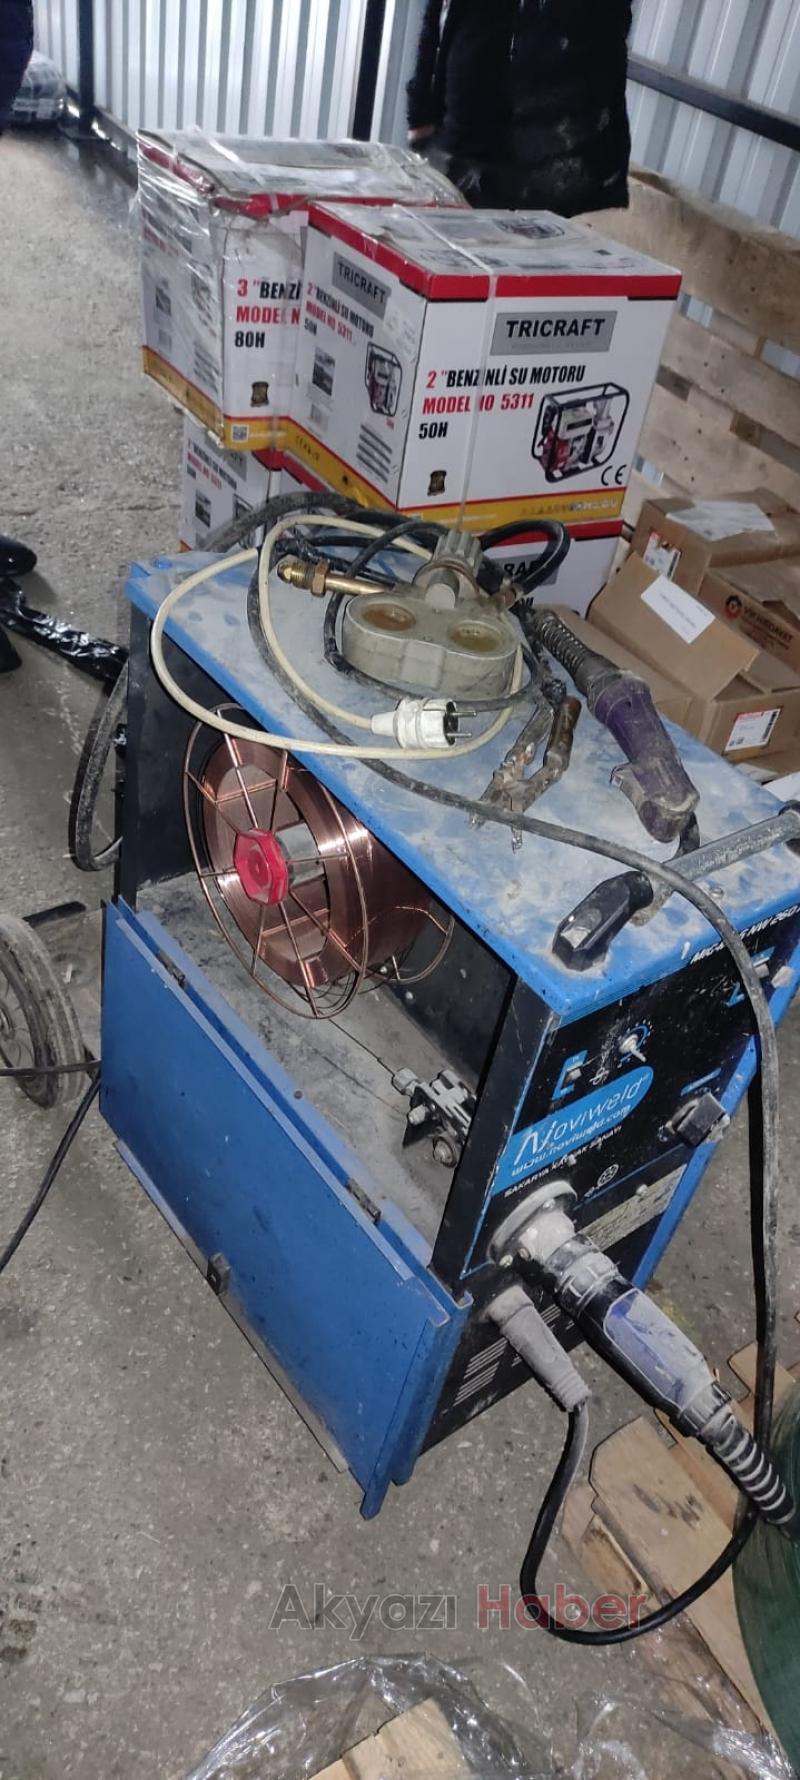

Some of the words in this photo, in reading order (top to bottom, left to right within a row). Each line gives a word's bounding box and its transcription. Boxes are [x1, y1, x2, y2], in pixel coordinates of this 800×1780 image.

[237, 278, 248, 297] 3
[338, 261, 386, 303] TRICRAFT
[234, 330, 265, 348] 80H
[505, 318, 606, 339] TRICRAFT
[425, 371, 438, 389] 2
[509, 366, 529, 385] SU
[529, 365, 586, 385] MOTORU
[422, 396, 471, 415] MODEL
[500, 392, 535, 411] 5311
[418, 421, 449, 440] 50H
